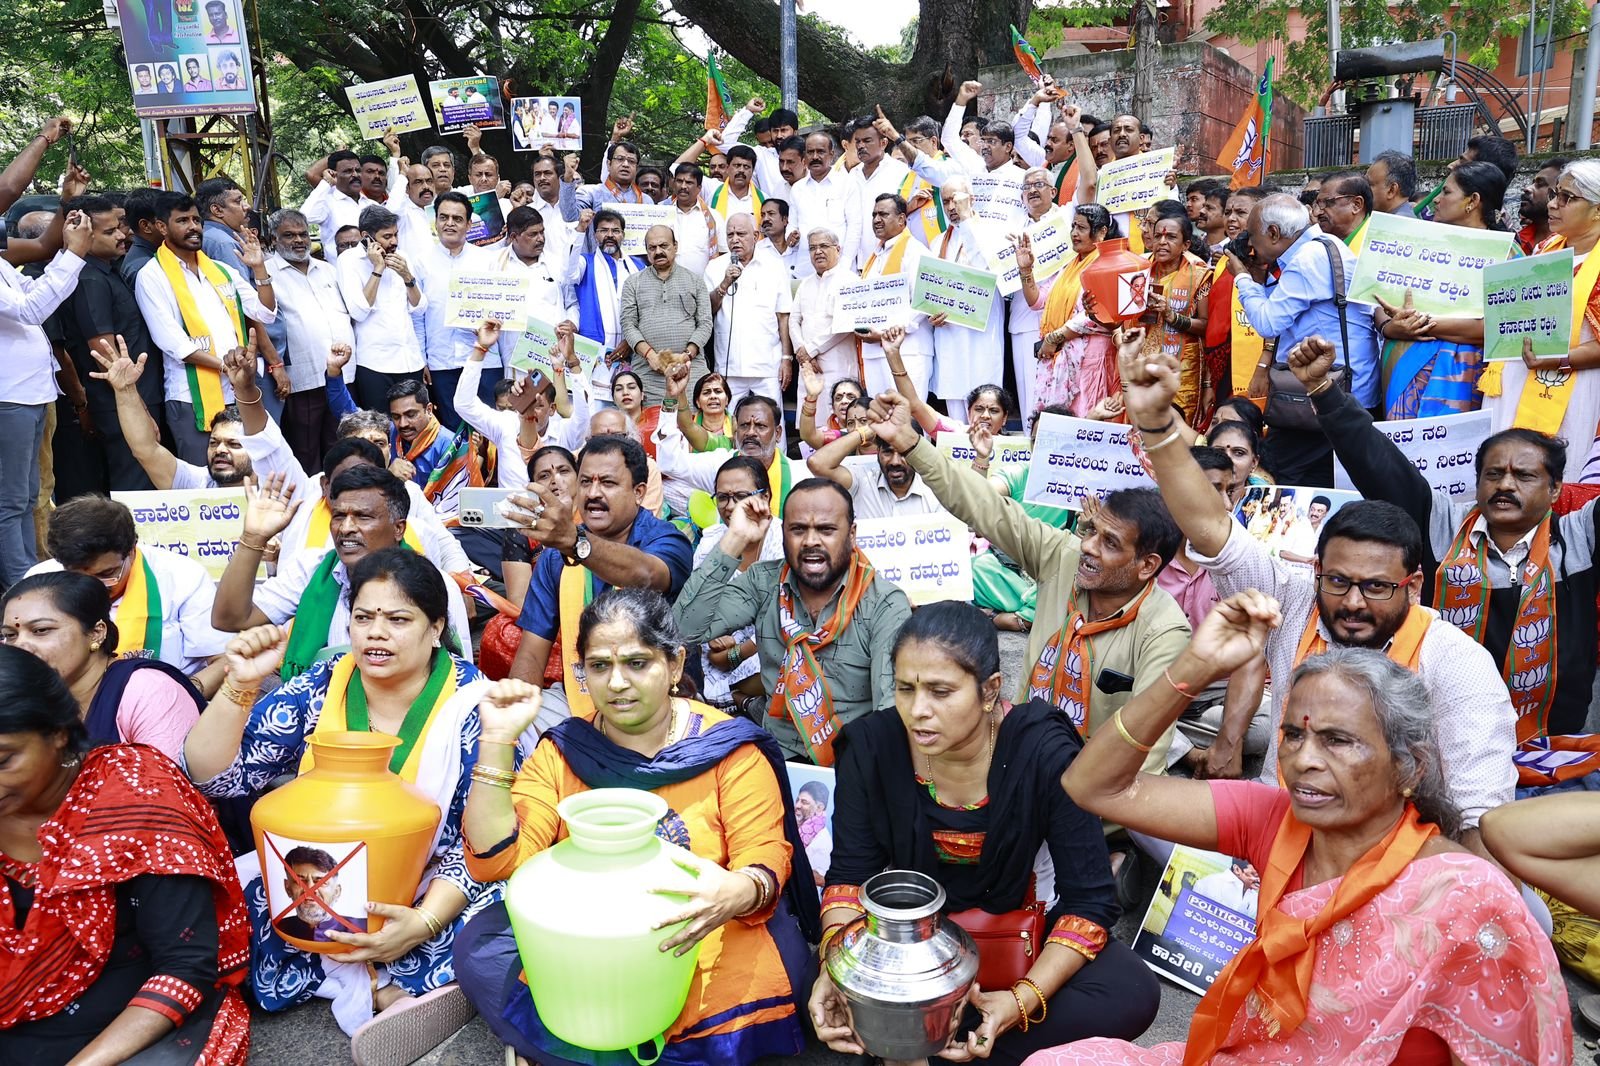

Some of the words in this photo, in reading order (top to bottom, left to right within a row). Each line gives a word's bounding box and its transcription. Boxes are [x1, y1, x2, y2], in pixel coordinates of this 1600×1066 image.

[1369, 240, 1413, 258] ಕಾವೇರಿ
[1418, 248, 1451, 265] ನೀರು
[839, 285, 871, 296] ಹೋರಾಟ
[873, 278, 905, 290] ಹೋರಾಟ
[920, 272, 943, 285] ಕಾವೇರಿ
[946, 279, 965, 291] ನೀರು
[968, 286, 989, 298] ಉಳಿಸಿ
[1376, 270, 1433, 291] ಕರ್ನಾಟಕ
[1439, 281, 1470, 301] ರಕ್ಷಿಸಿ
[1487, 288, 1517, 306] ಕಾವೇರಿ
[1521, 284, 1542, 302] ನೀರು
[1546, 281, 1568, 298] ಉಳಿಸಿ
[842, 300, 868, 311] ಕಾವೇರಿ
[924, 291, 955, 307] ಕರ್ನಾಟಕ
[958, 301, 976, 315] ರಕ್ಷಿಸಿ
[854, 315, 888, 325] ಹೋರಾಟ
[1498, 318, 1537, 335] ಕರ್ನಾಟಕ
[1540, 316, 1557, 336] ರಕ್ಷಿಸಿ
[524, 331, 548, 346] ಕಾವೇರಿ
[527, 350, 551, 367] ಕರ್ನಾಟ
[1076, 428, 1104, 442] ಜೀವ
[1422, 425, 1447, 441] ನದಿ
[1001, 449, 1032, 463] ನೀರು
[1048, 452, 1109, 472] ಕಾವೇರಿಯ
[1114, 461, 1145, 477] ನೀರು
[1436, 450, 1473, 469] ನೀರು
[1046, 481, 1089, 503] ನಮ್ಮದು
[133, 503, 190, 524] ಕಾವೇರಿ
[199, 501, 240, 521] ನೀರು
[856, 530, 906, 549] ಕಾವೇರಿ
[915, 526, 951, 546] ನೀರು
[910, 560, 960, 586] ನಮ್ಮದು
[1514, 701, 1540, 719] JP
[1189, 896, 1253, 932] POLITICAL
[1151, 944, 1204, 977] ಕಾವೇರಿ
